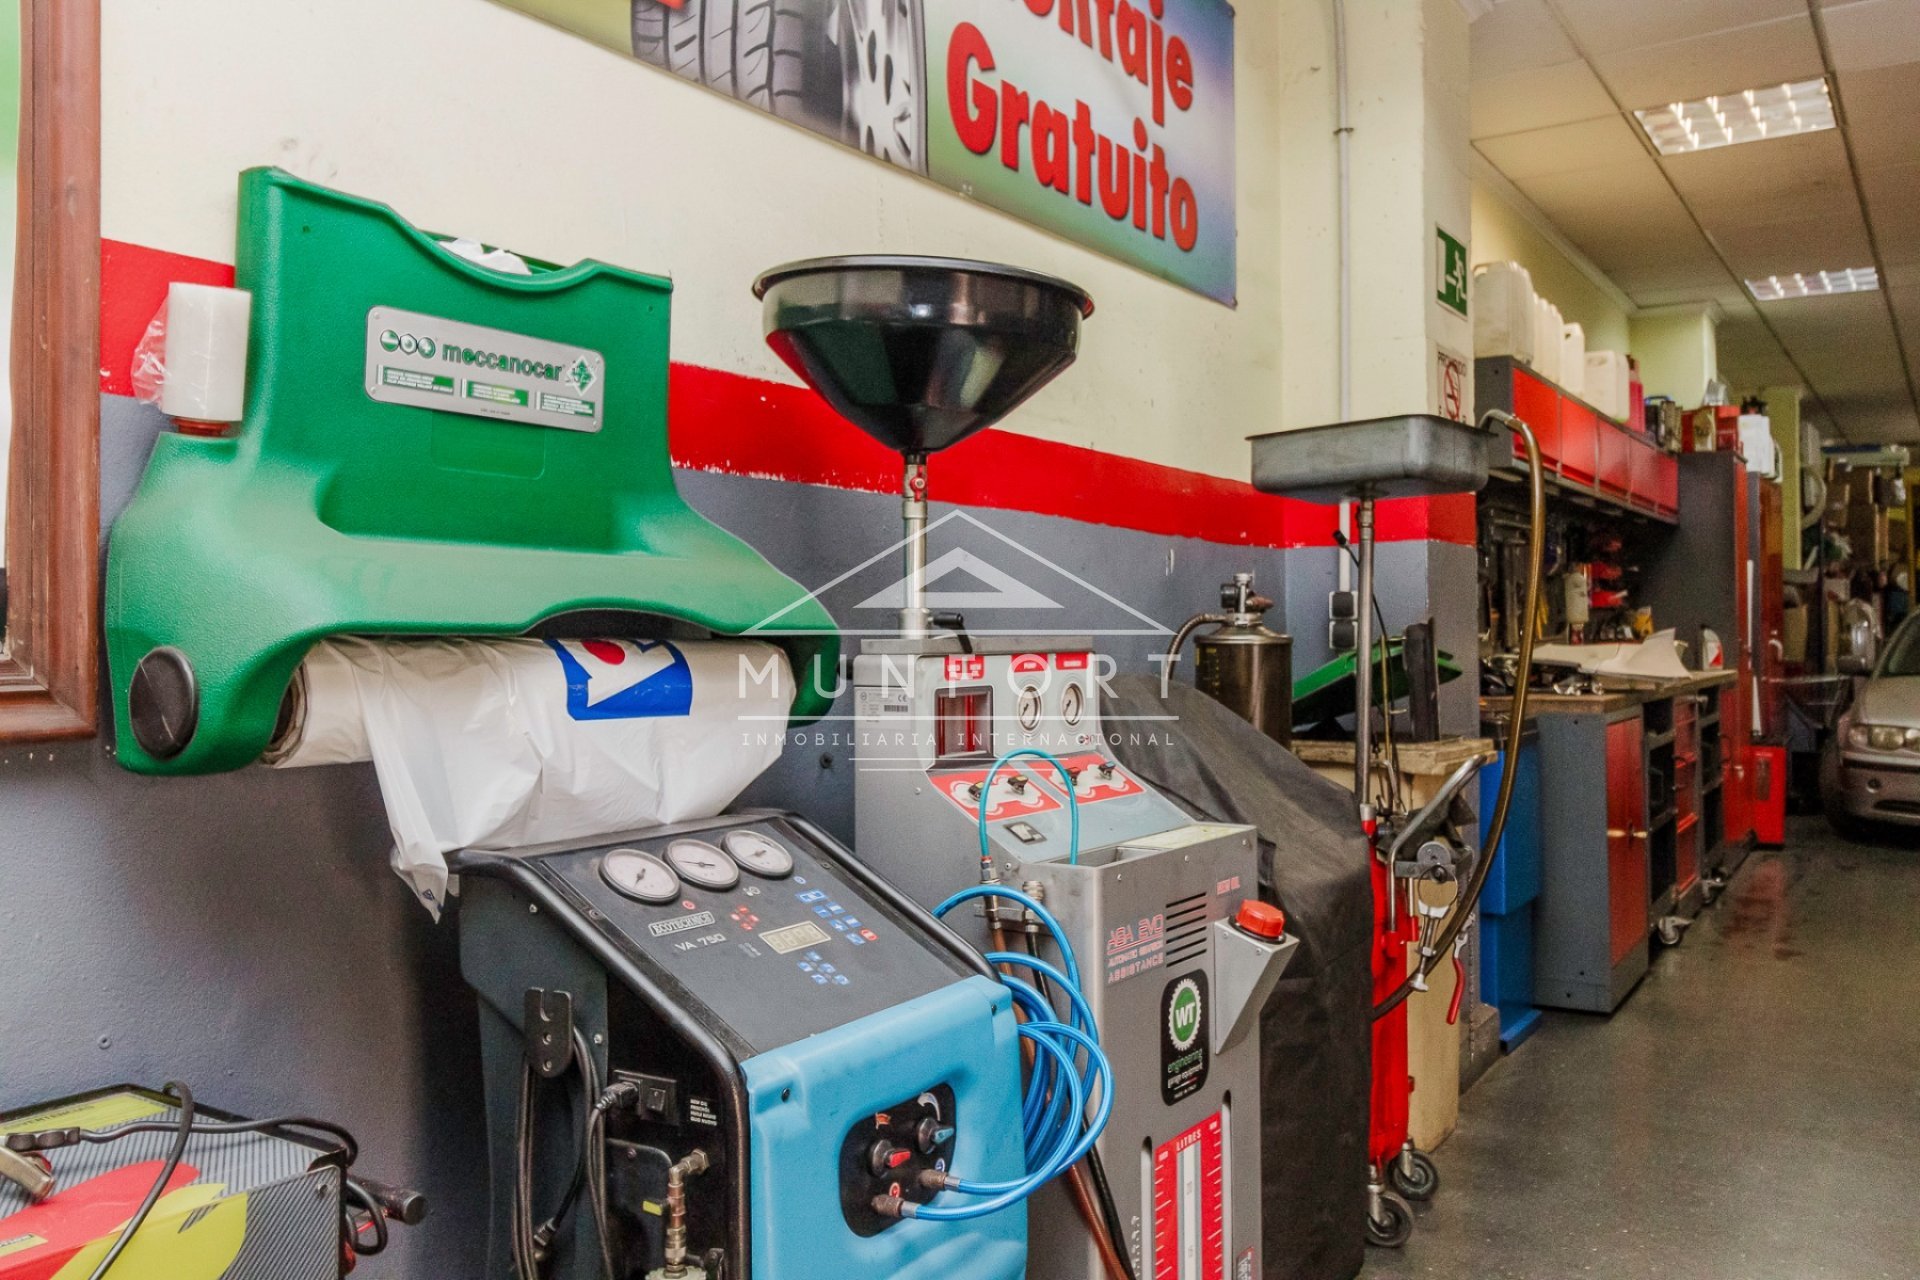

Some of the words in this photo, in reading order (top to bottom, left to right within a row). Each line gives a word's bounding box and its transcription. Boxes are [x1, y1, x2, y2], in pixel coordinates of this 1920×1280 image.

[947, 21, 1198, 252] Gratuito
[442, 343, 562, 381] meccanocar
[674, 941, 698, 951] VA
[696, 933, 727, 946] 750
[1175, 1002, 1196, 1029] WT
[1175, 1128, 1202, 1152] LITRES
